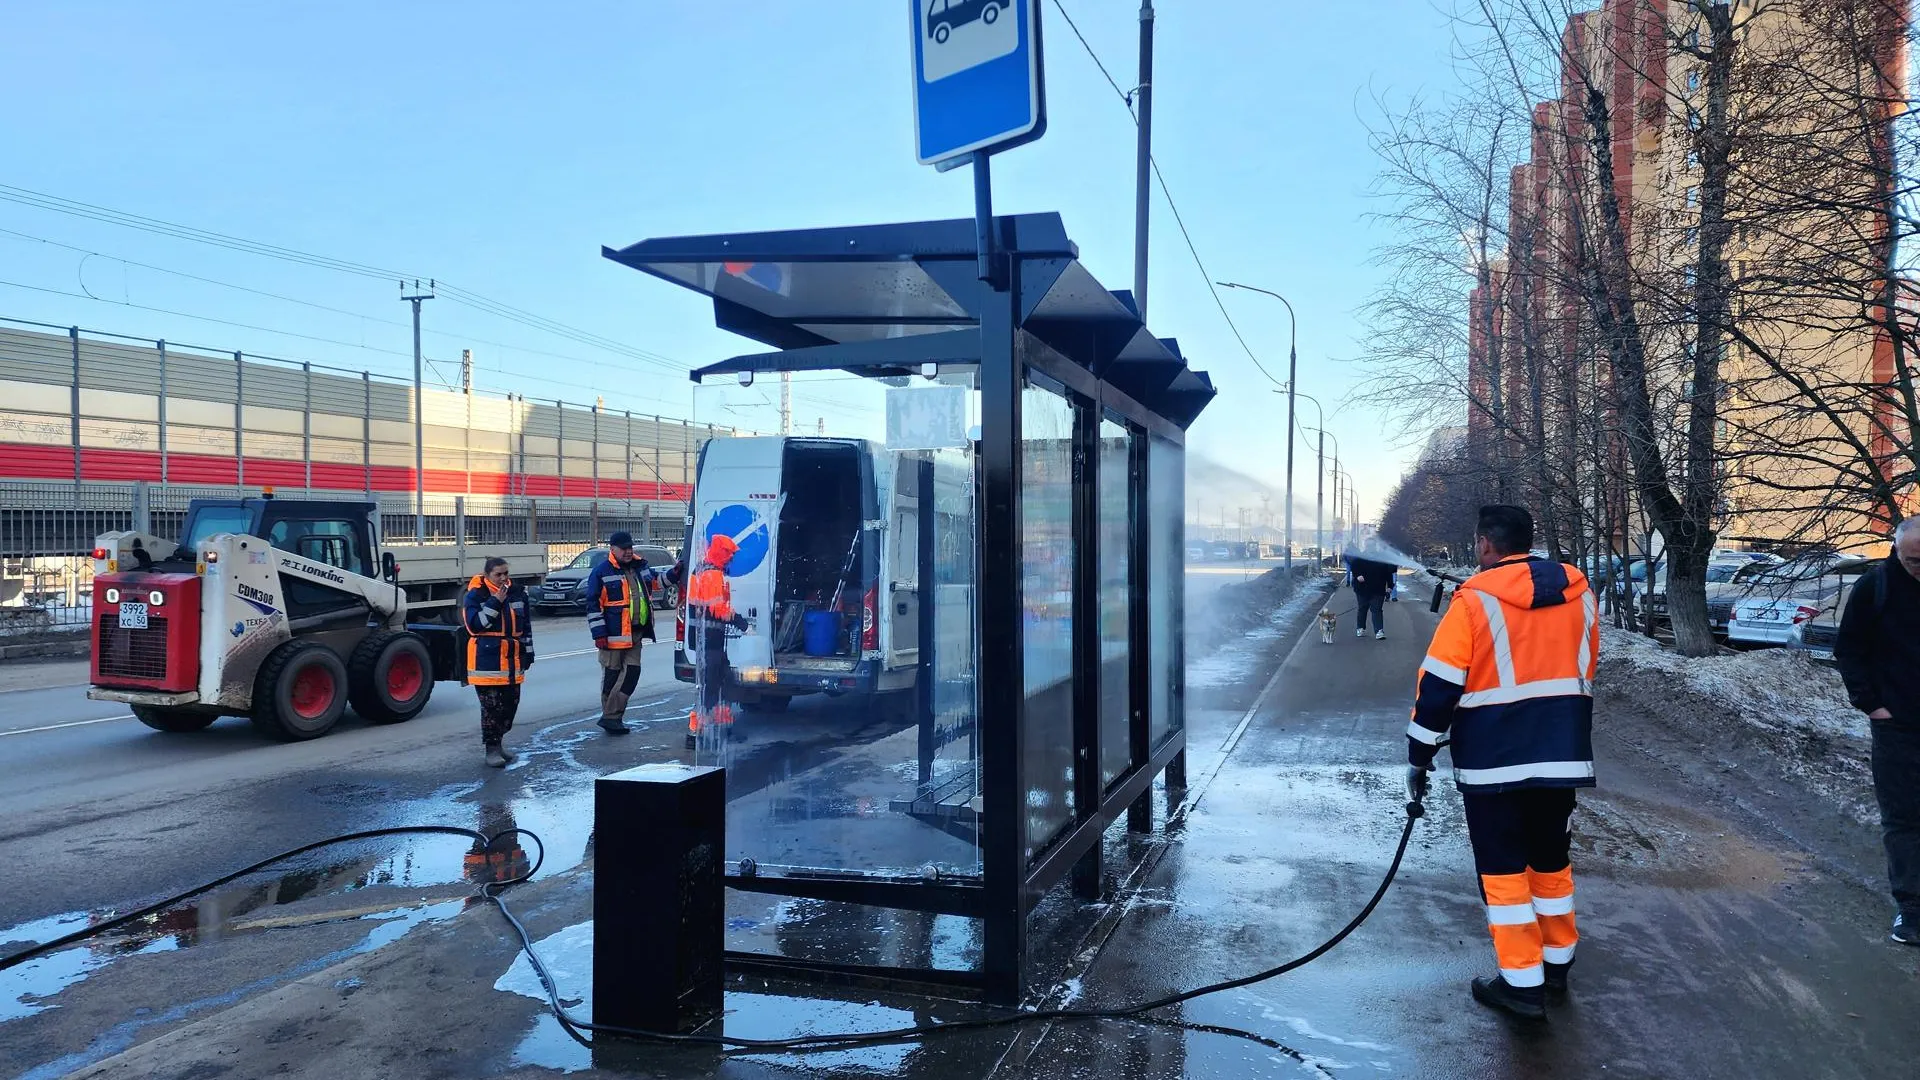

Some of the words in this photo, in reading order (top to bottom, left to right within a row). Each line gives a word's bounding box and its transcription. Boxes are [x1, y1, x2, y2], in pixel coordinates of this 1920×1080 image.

[237, 583, 274, 605] CDM308
[122, 603, 144, 615] 3992
[136, 616, 146, 625] 50
